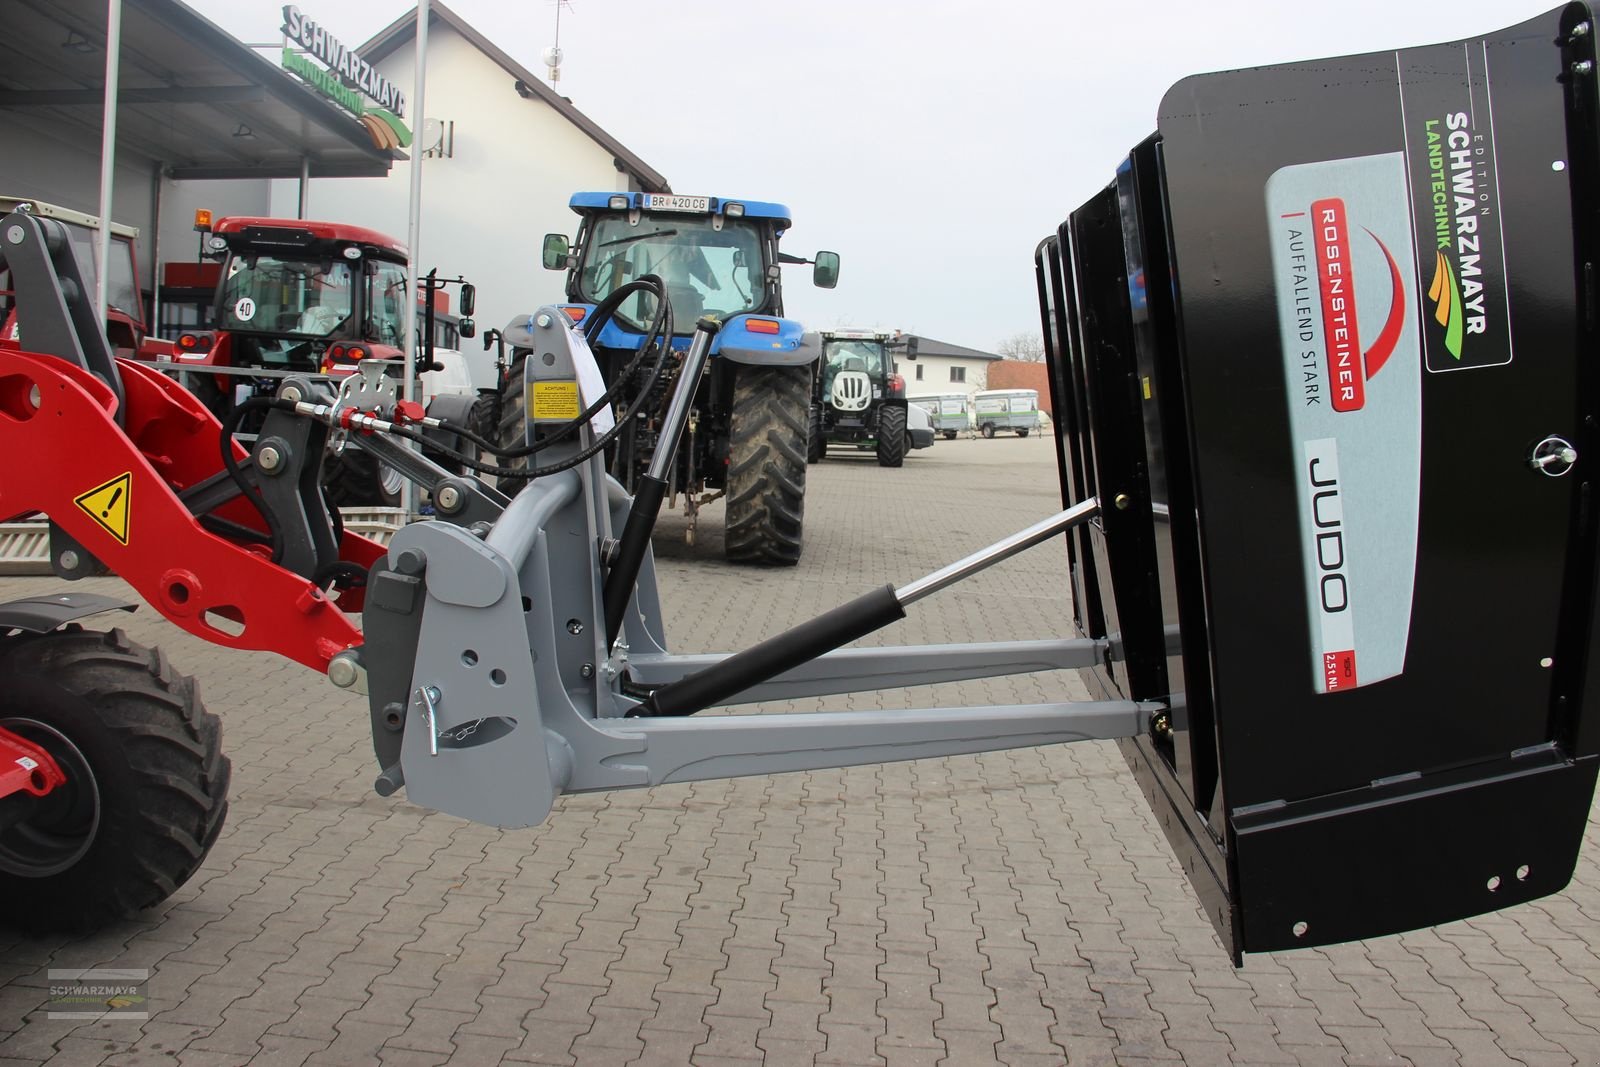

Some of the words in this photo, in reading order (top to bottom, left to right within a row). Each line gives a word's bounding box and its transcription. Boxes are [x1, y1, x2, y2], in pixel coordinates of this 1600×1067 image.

[281, 5, 406, 118] SCHWARZMAYR
[652, 196, 664, 207] BR
[672, 198, 690, 208] 420
[693, 199, 705, 209] CG
[1424, 119, 1451, 250] LANDTECHNIK
[1446, 111, 1487, 336] SCHWARZMAYR
[1475, 134, 1490, 216] EDITION
[239, 302, 251, 317] 40
[1288, 229, 1314, 342] AUFFALLEND
[1301, 351, 1321, 406] STARK
[1322, 209, 1355, 401] ROSENSTEINER
[1309, 458, 1349, 613] JUDO
[1328, 677, 1339, 691] NL
